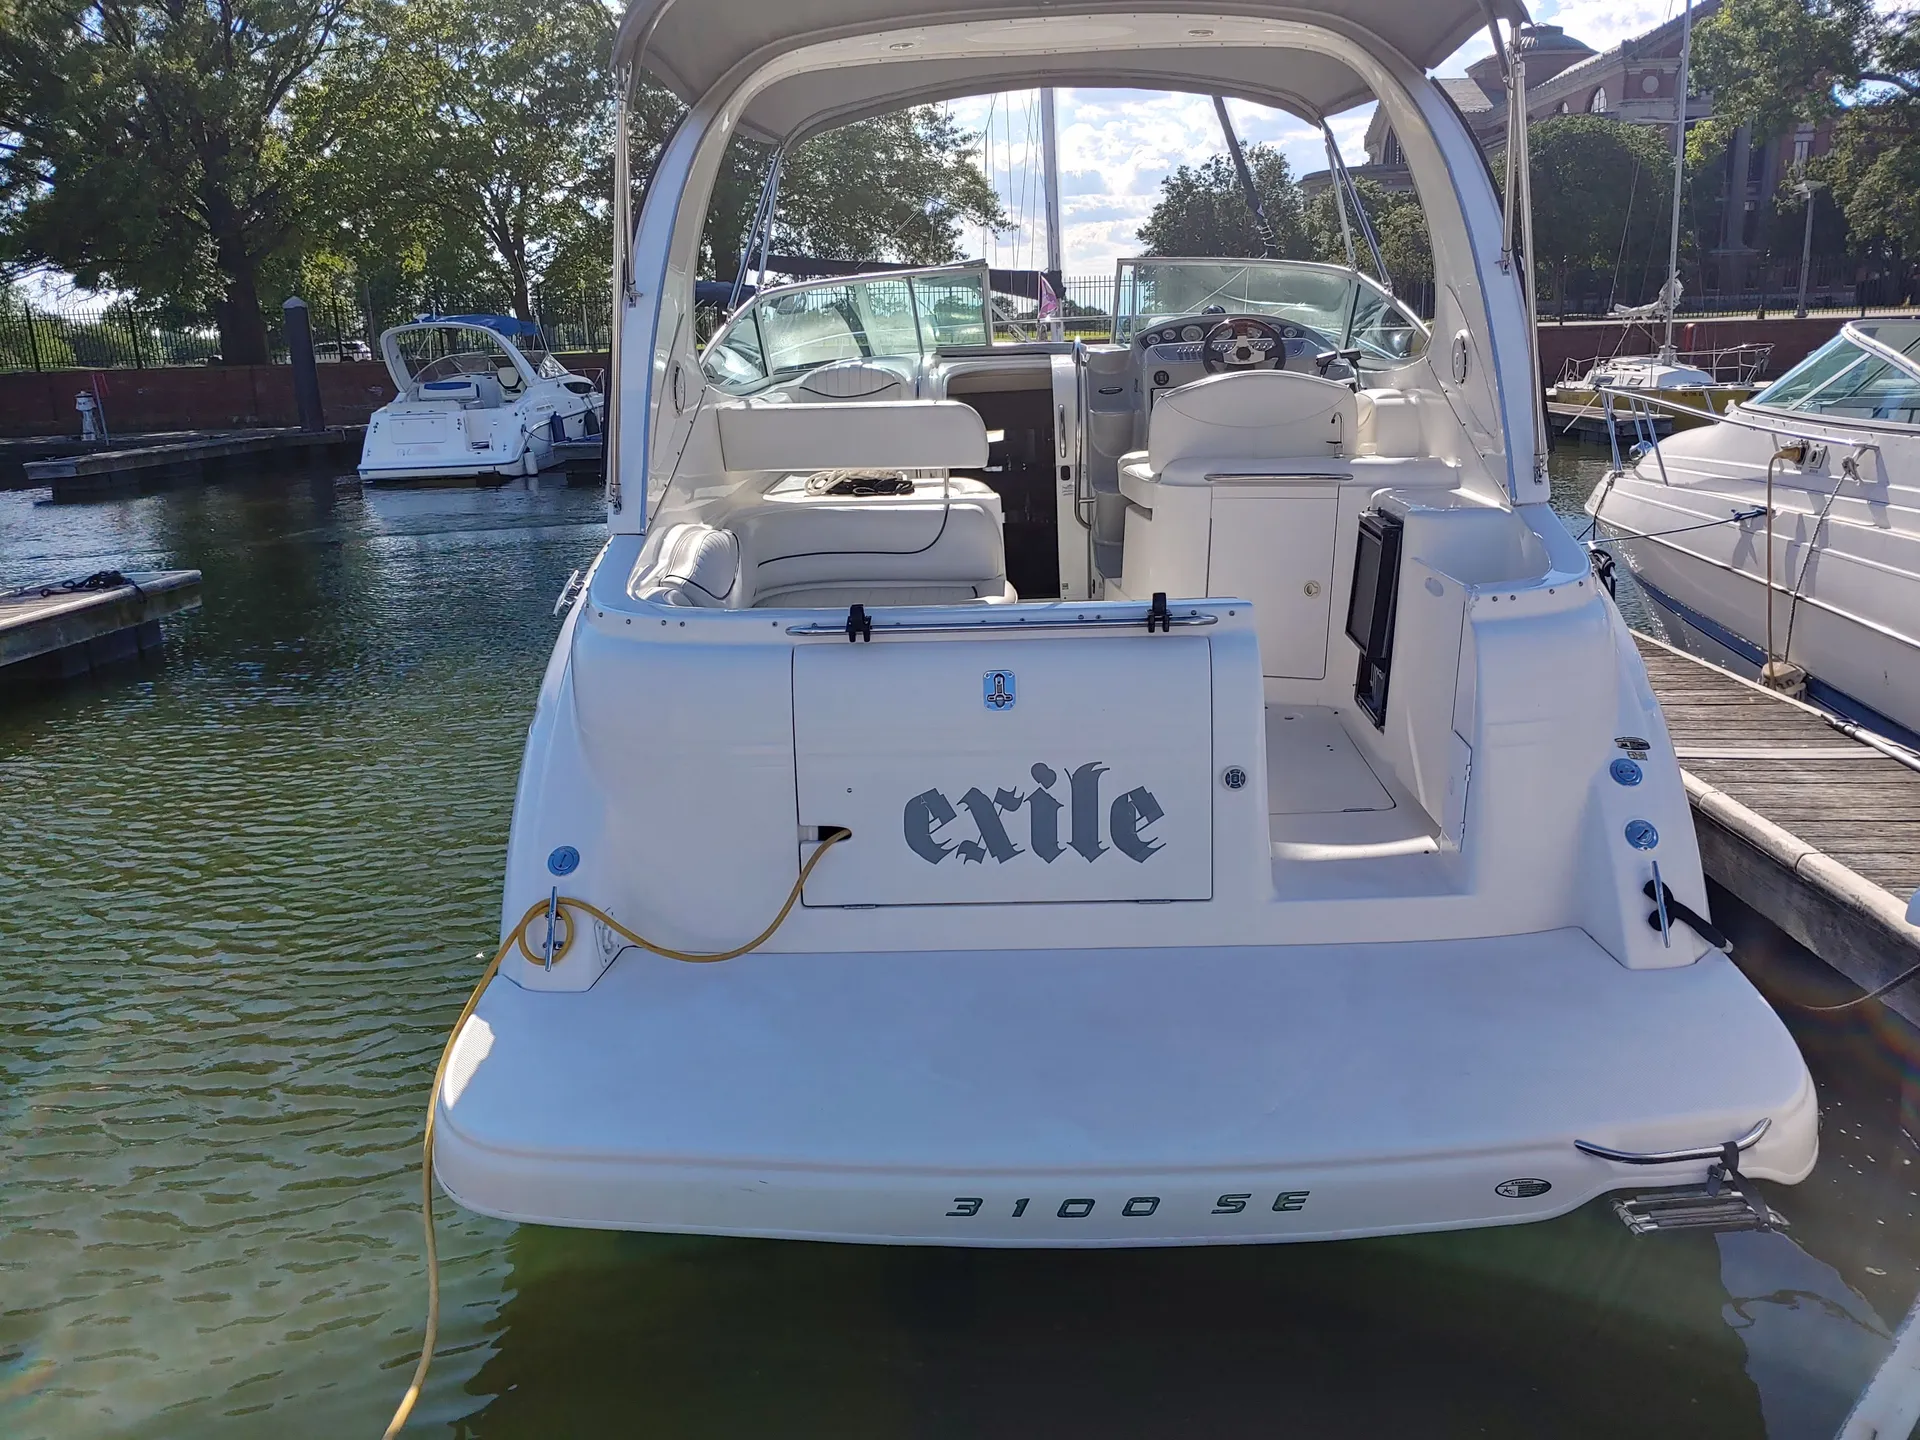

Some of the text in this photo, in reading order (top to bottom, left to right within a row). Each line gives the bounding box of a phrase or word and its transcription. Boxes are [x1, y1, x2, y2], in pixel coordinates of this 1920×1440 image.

[904, 762, 1167, 865] exile
[945, 1191, 1311, 1218] 3100 SE
